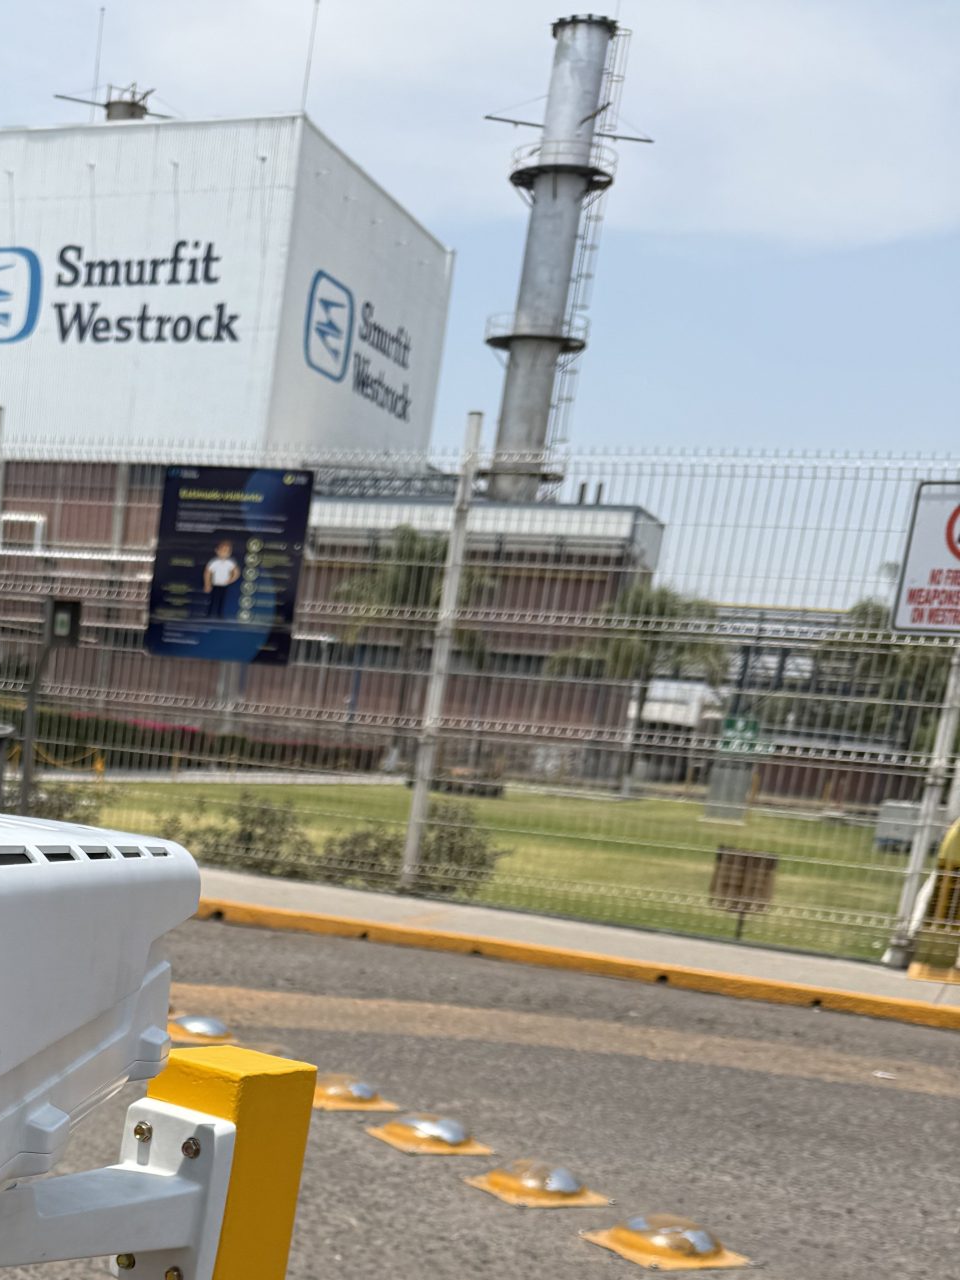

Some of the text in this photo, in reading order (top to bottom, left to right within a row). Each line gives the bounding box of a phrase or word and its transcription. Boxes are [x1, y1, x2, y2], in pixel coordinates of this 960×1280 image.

[56, 239, 222, 288] Smurfit
[52, 301, 240, 344] Westrock
[358, 300, 411, 370] Smurfit
[352, 351, 412, 423] Westrock
